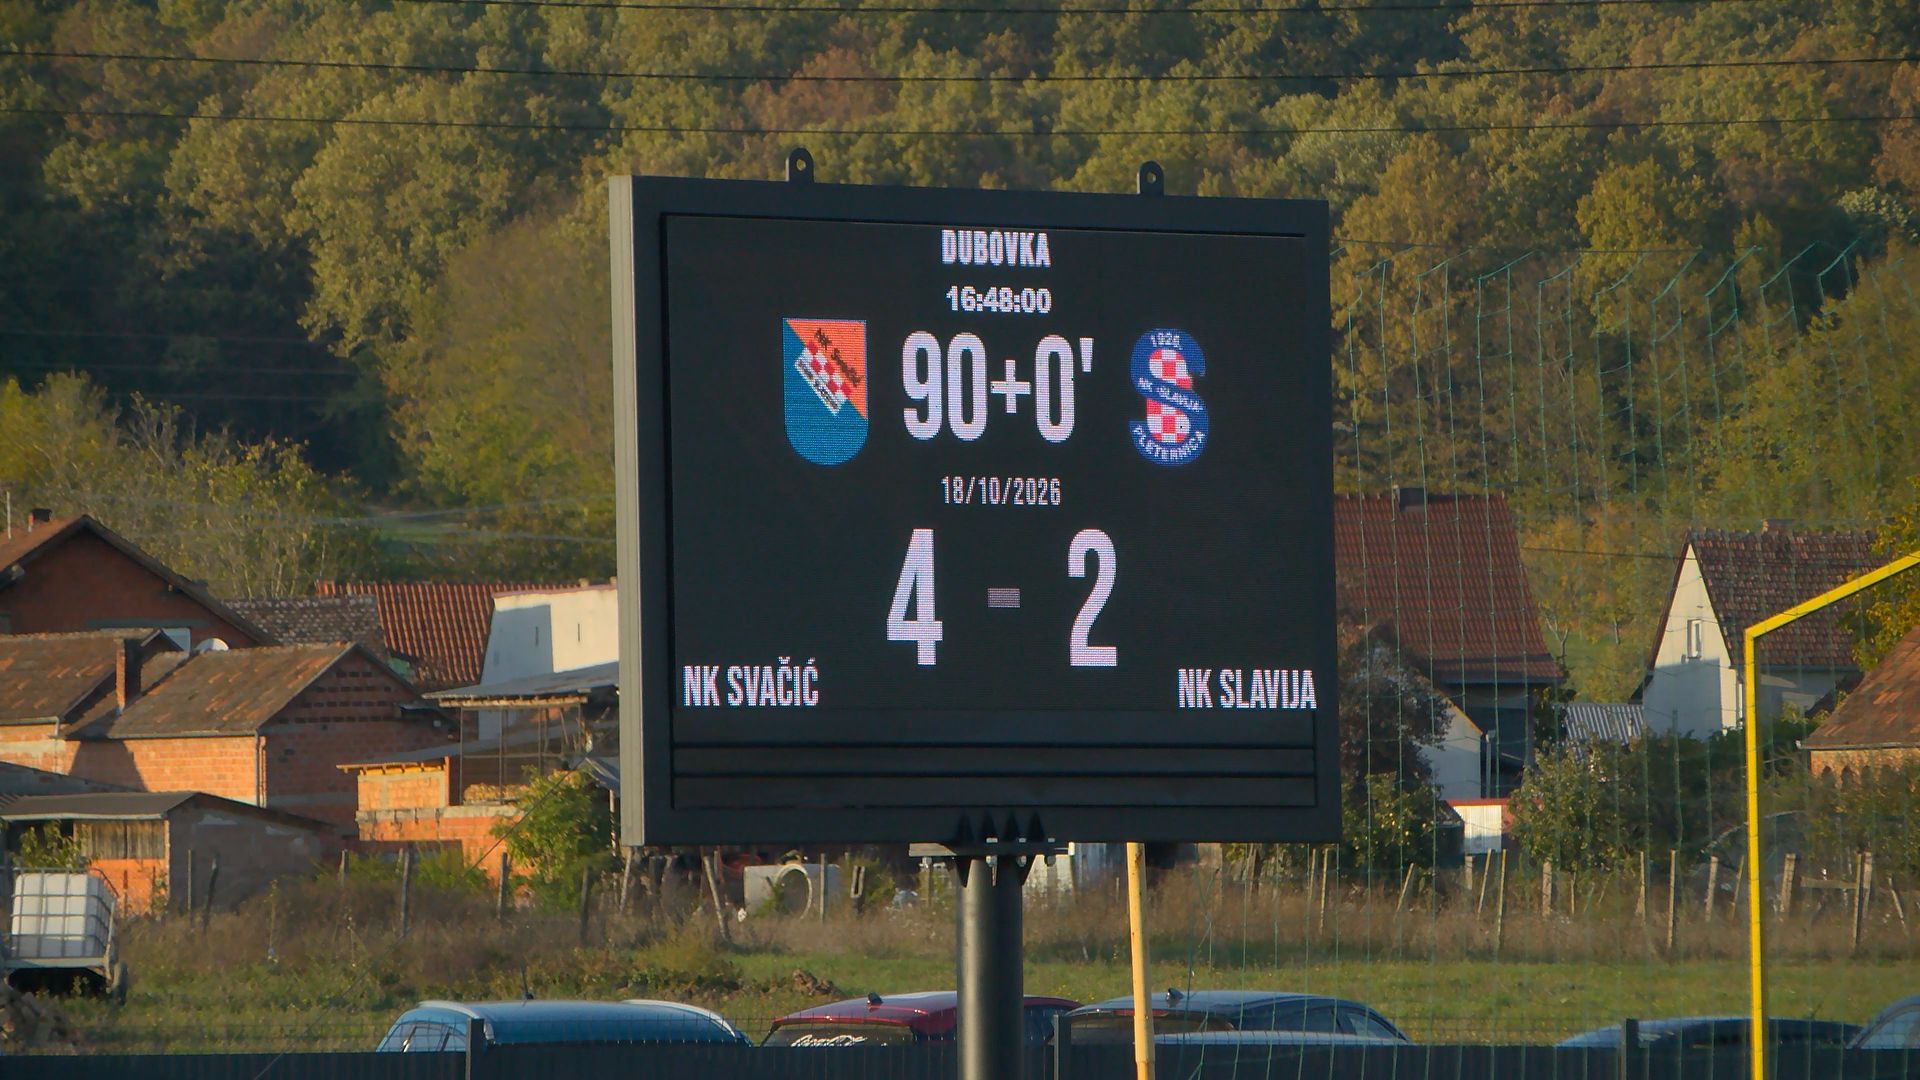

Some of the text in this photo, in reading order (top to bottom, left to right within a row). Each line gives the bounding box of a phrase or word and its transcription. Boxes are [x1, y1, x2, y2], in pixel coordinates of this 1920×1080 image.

[941, 229, 1052, 267] DUBOVKA
[946, 285, 1052, 314] 16:48:00
[902, 330, 1095, 443] 90+0'
[941, 476, 1062, 505] 18/10/2026
[886, 528, 943, 666] 4
[1067, 528, 1118, 667] 2
[682, 657, 820, 707] NK SVAČIĆ
[1177, 668, 1318, 710] NK SLAVIJA
